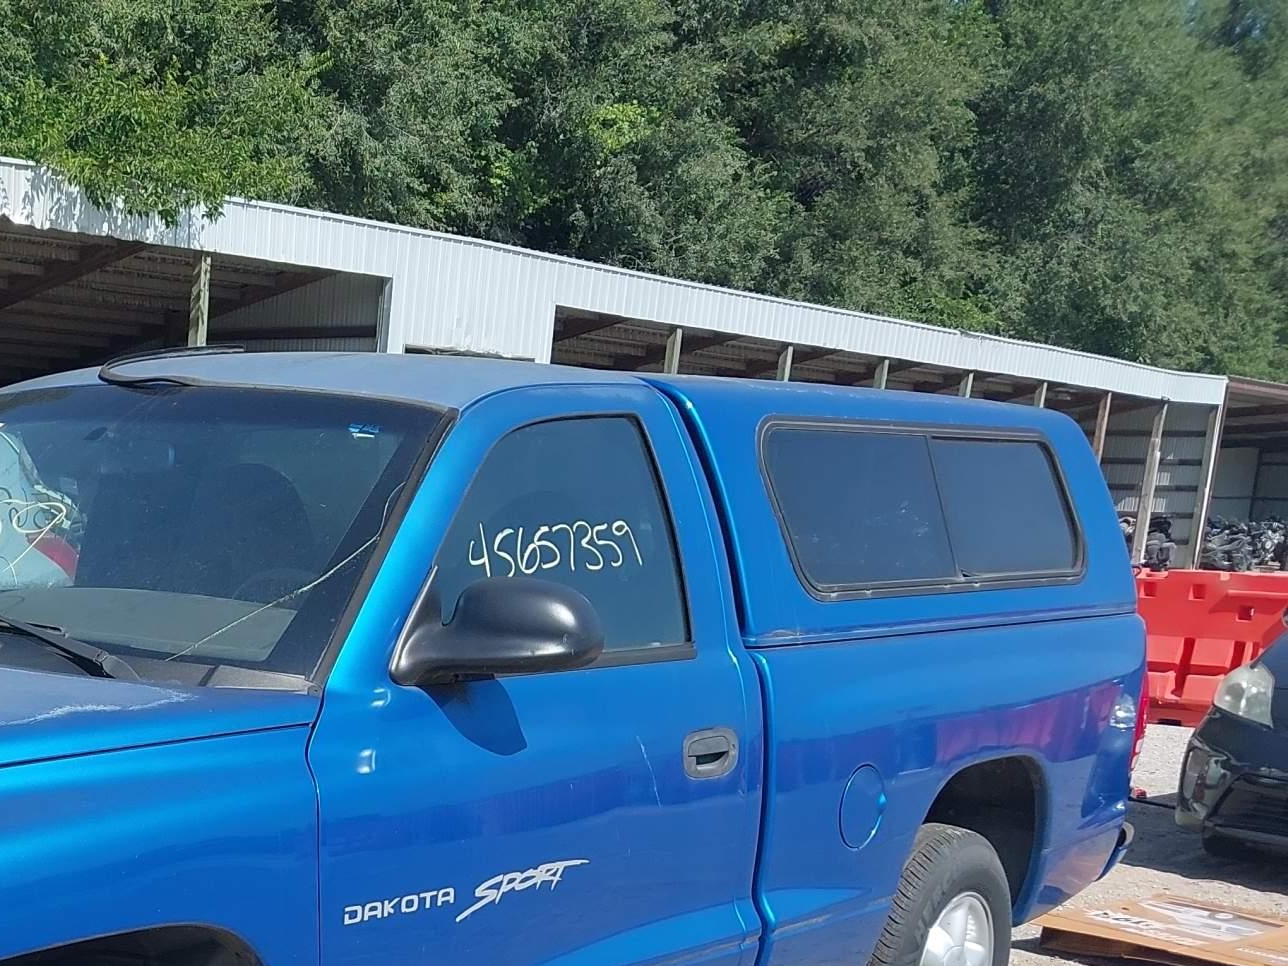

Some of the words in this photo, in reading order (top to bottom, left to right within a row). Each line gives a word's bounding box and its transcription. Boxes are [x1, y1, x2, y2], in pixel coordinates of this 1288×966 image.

[469, 520, 643, 577] 45657359
[343, 887, 455, 925] DAKOTA
[455, 858, 591, 923] SPORT
